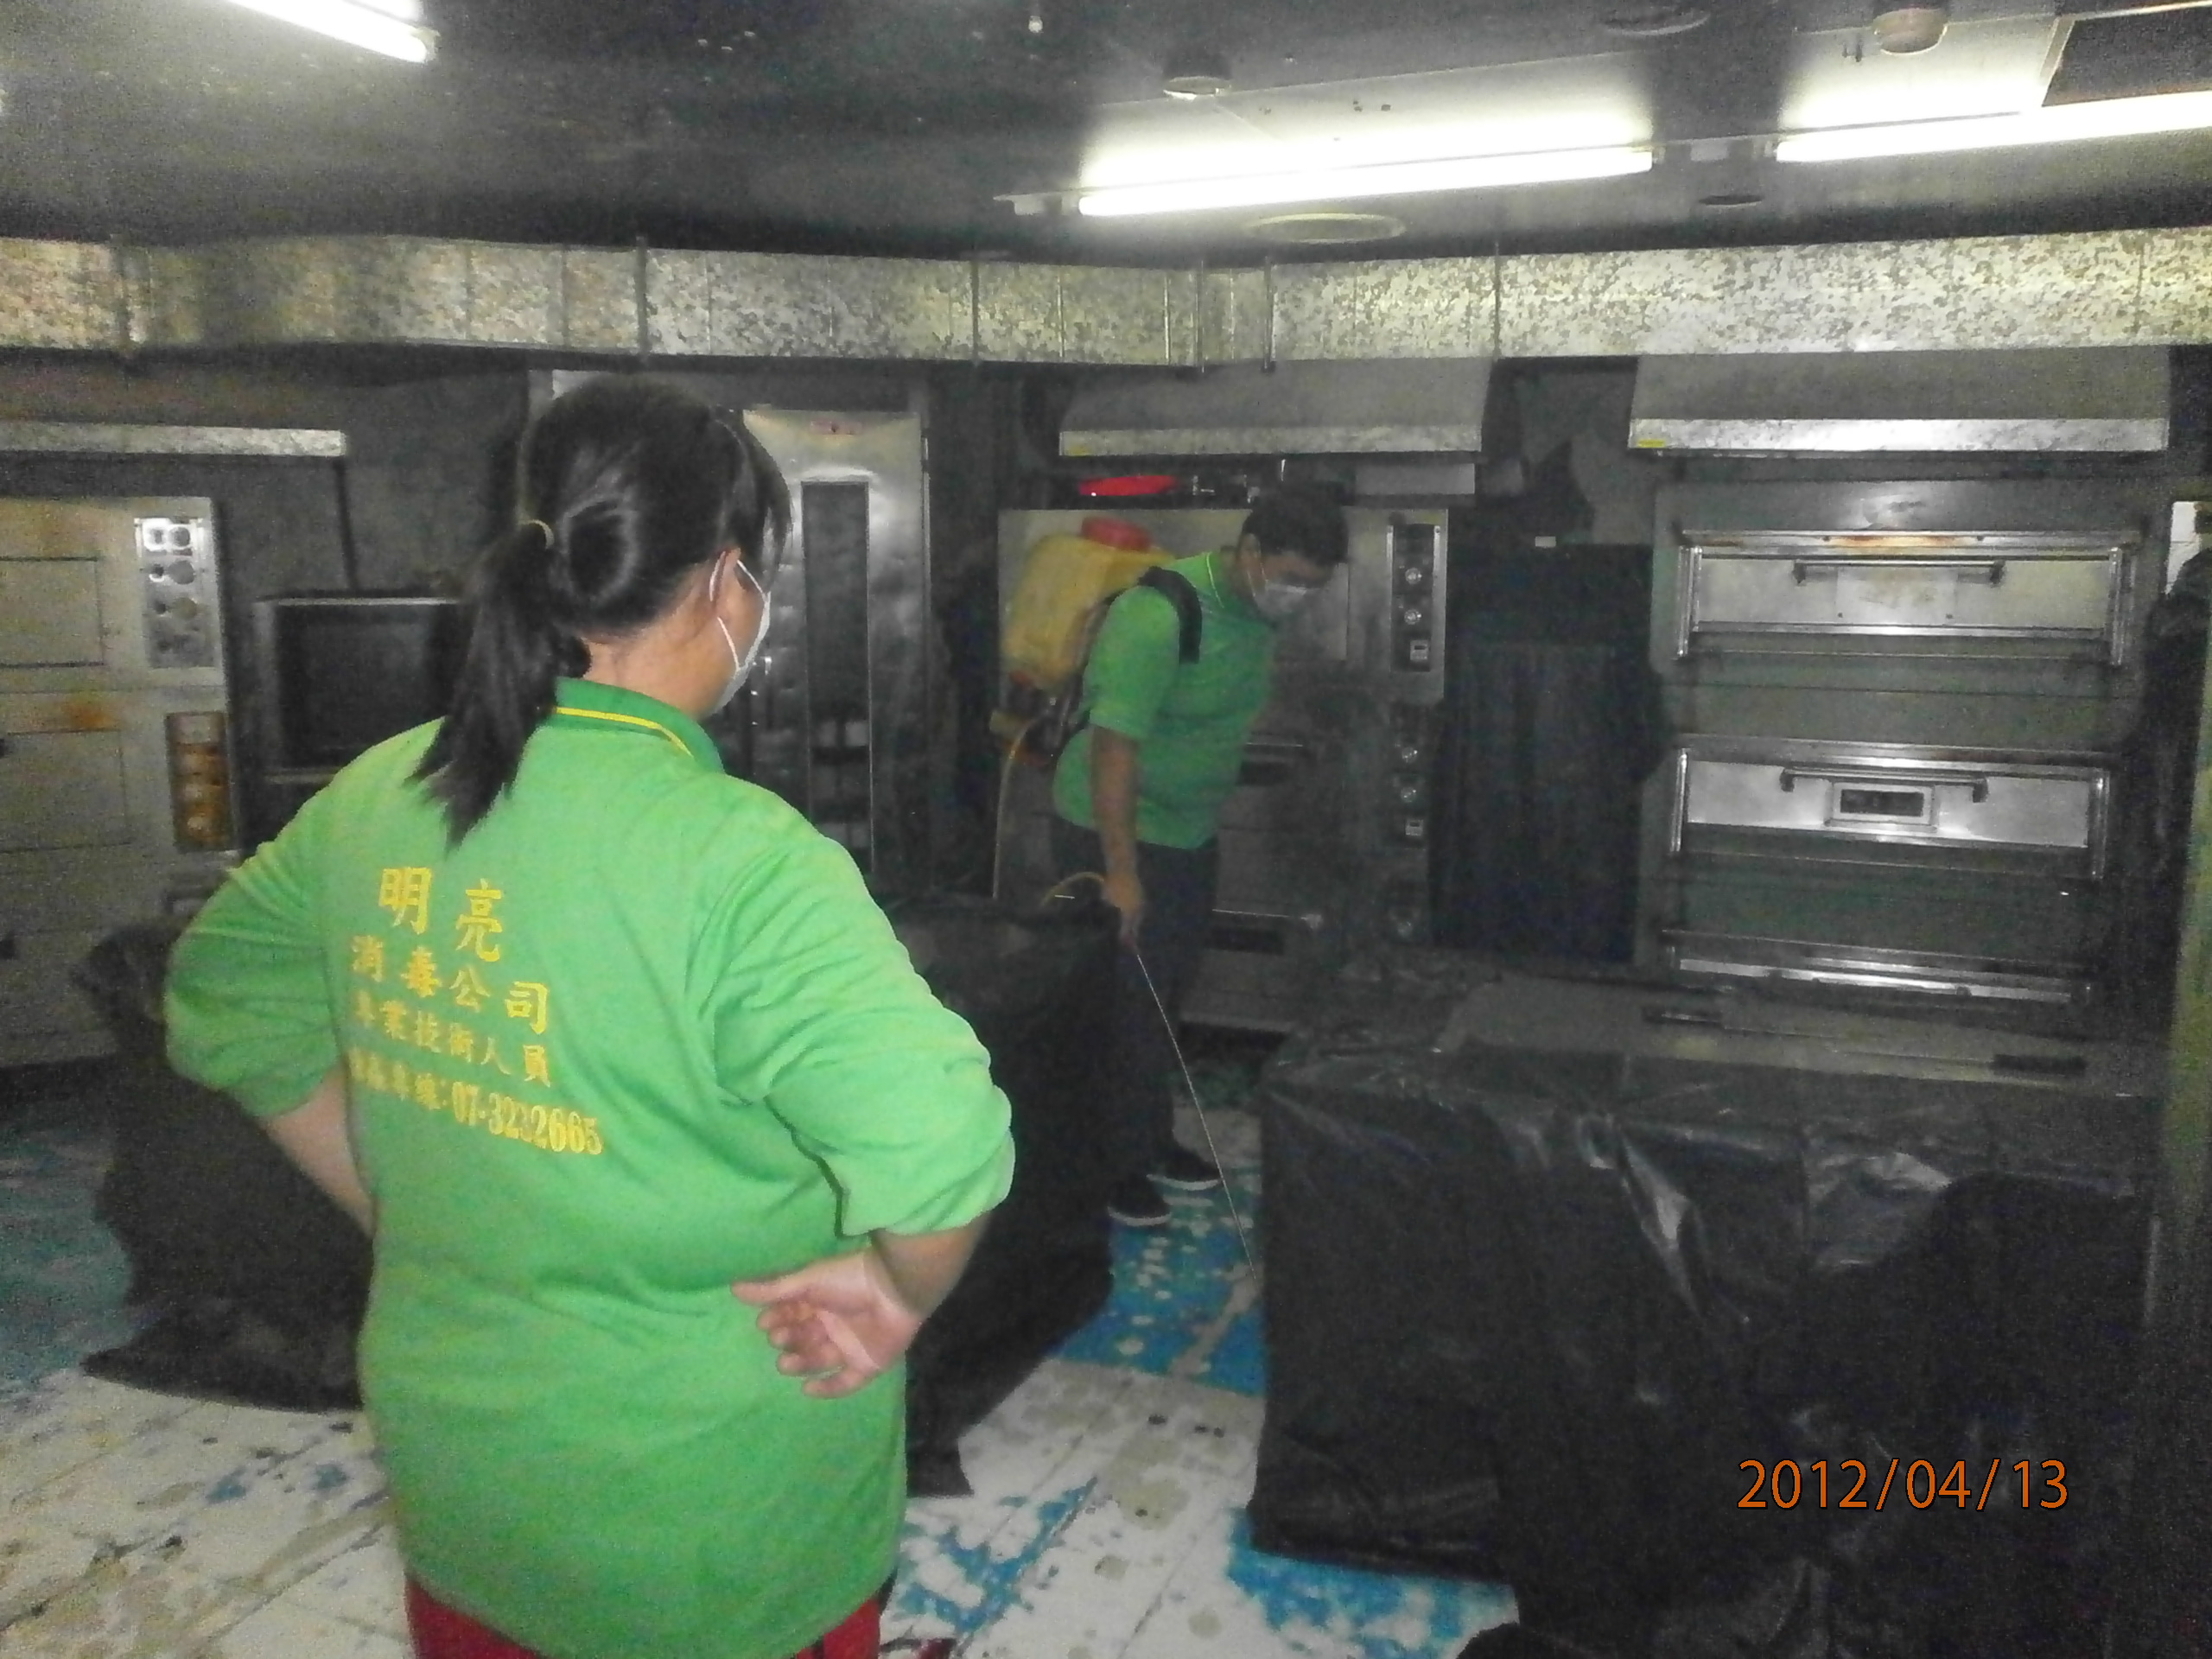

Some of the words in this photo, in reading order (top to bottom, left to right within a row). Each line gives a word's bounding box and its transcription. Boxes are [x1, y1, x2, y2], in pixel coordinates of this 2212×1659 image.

[378, 867, 503, 962] 明亮
[351, 935, 549, 1035] 消毒公司
